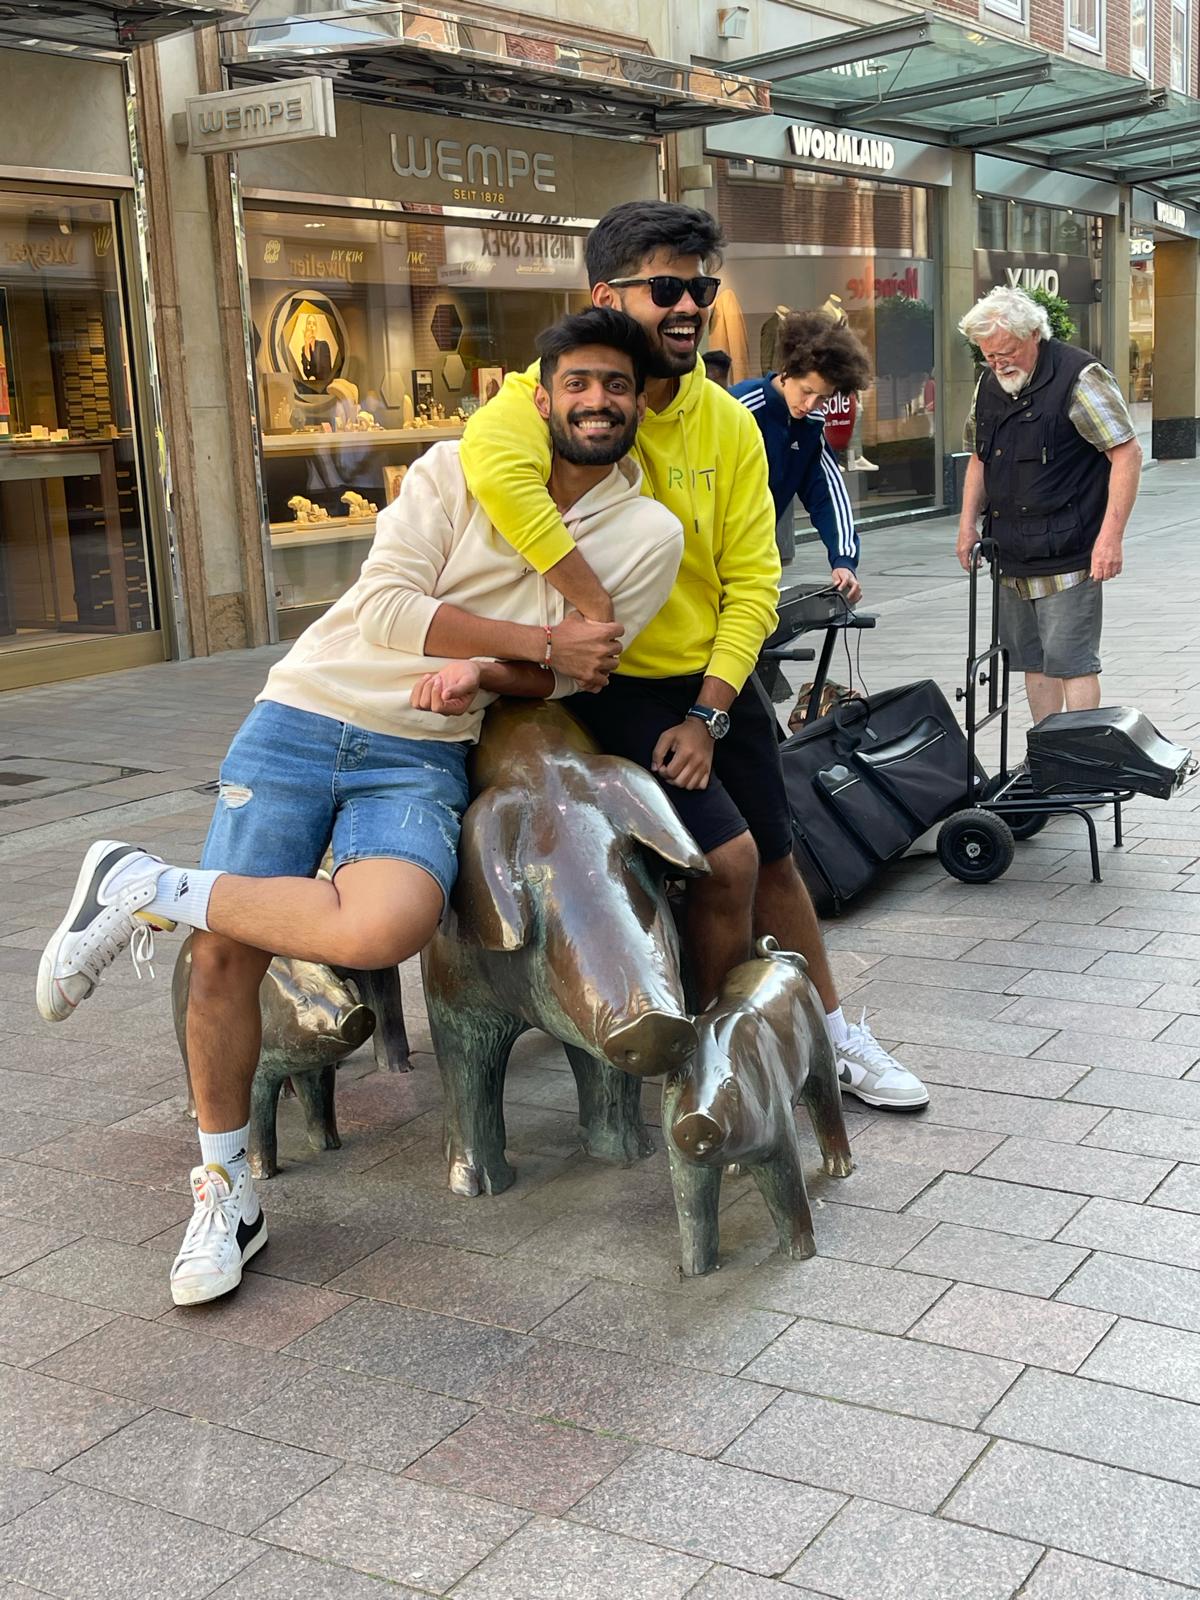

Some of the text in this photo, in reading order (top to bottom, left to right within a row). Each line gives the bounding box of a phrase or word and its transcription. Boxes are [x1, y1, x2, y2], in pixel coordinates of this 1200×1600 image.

[198, 97, 302, 134] WEMPE
[390, 133, 557, 193] WEMPE
[789, 124, 895, 170] WORMLAND
[453, 188, 505, 204] SEIT 1878
